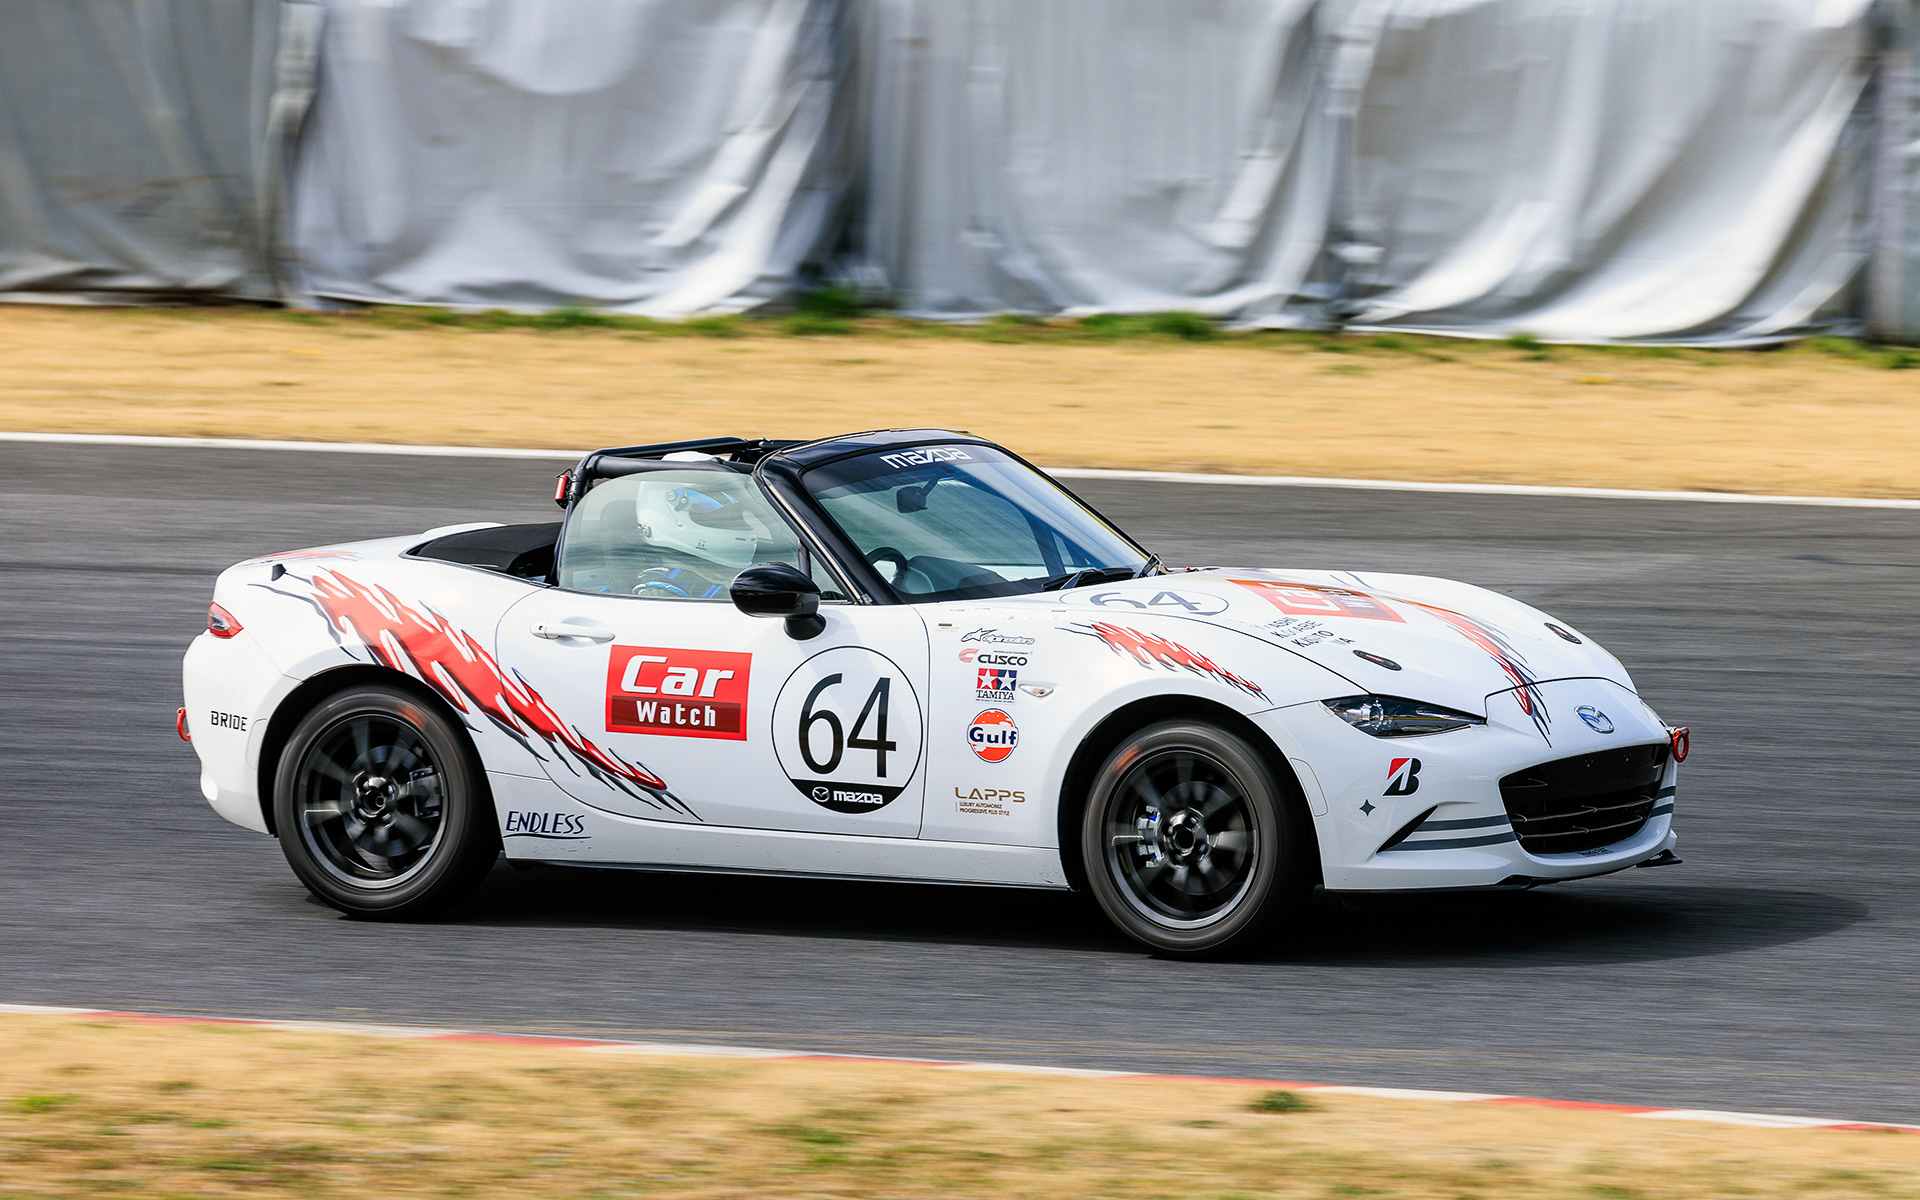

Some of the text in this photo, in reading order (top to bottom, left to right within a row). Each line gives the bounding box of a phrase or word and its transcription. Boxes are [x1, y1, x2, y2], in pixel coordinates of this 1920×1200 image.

[1089, 592, 1202, 611] 64
[977, 654, 1028, 667] CUSCO
[620, 654, 736, 699] Car
[975, 689, 1015, 701] TAMIYA
[210, 710, 248, 732] BRIDE
[635, 700, 717, 727] Watch
[798, 673, 897, 778] 64
[969, 726, 1017, 745] Gulf
[954, 786, 1026, 803] LAPPS
[505, 810, 585, 835] ENDLESS
